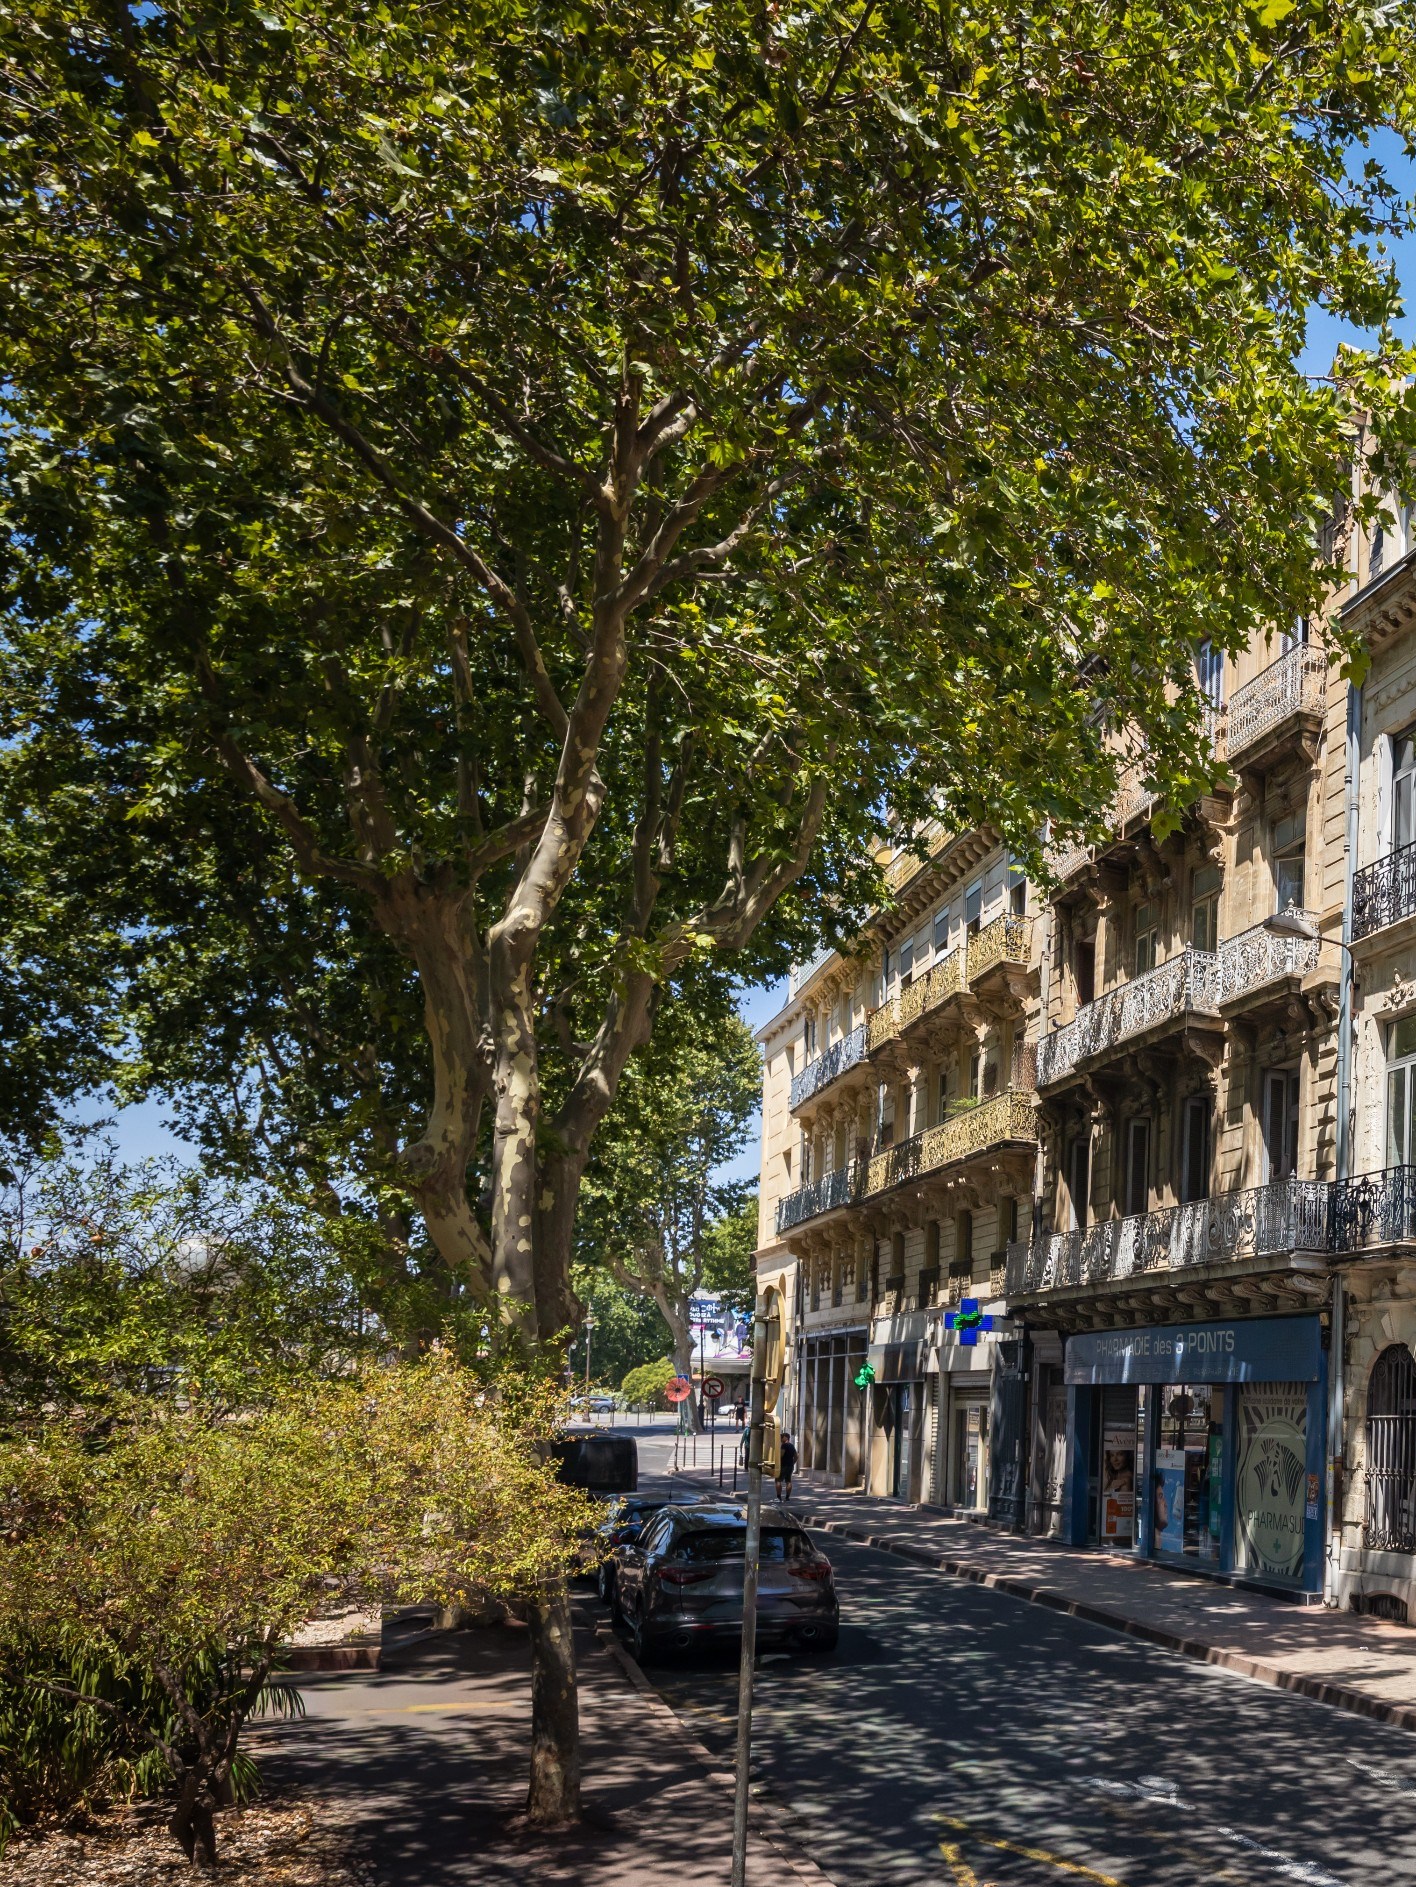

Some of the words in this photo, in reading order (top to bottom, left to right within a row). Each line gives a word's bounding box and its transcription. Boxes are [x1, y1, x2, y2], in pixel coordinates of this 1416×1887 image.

[1096, 1335, 1150, 1357] PHARMACIE
[1153, 1335, 1172, 1355] des
[1175, 1333, 1185, 1354] 3
[1188, 1330, 1235, 1353] PONTS
